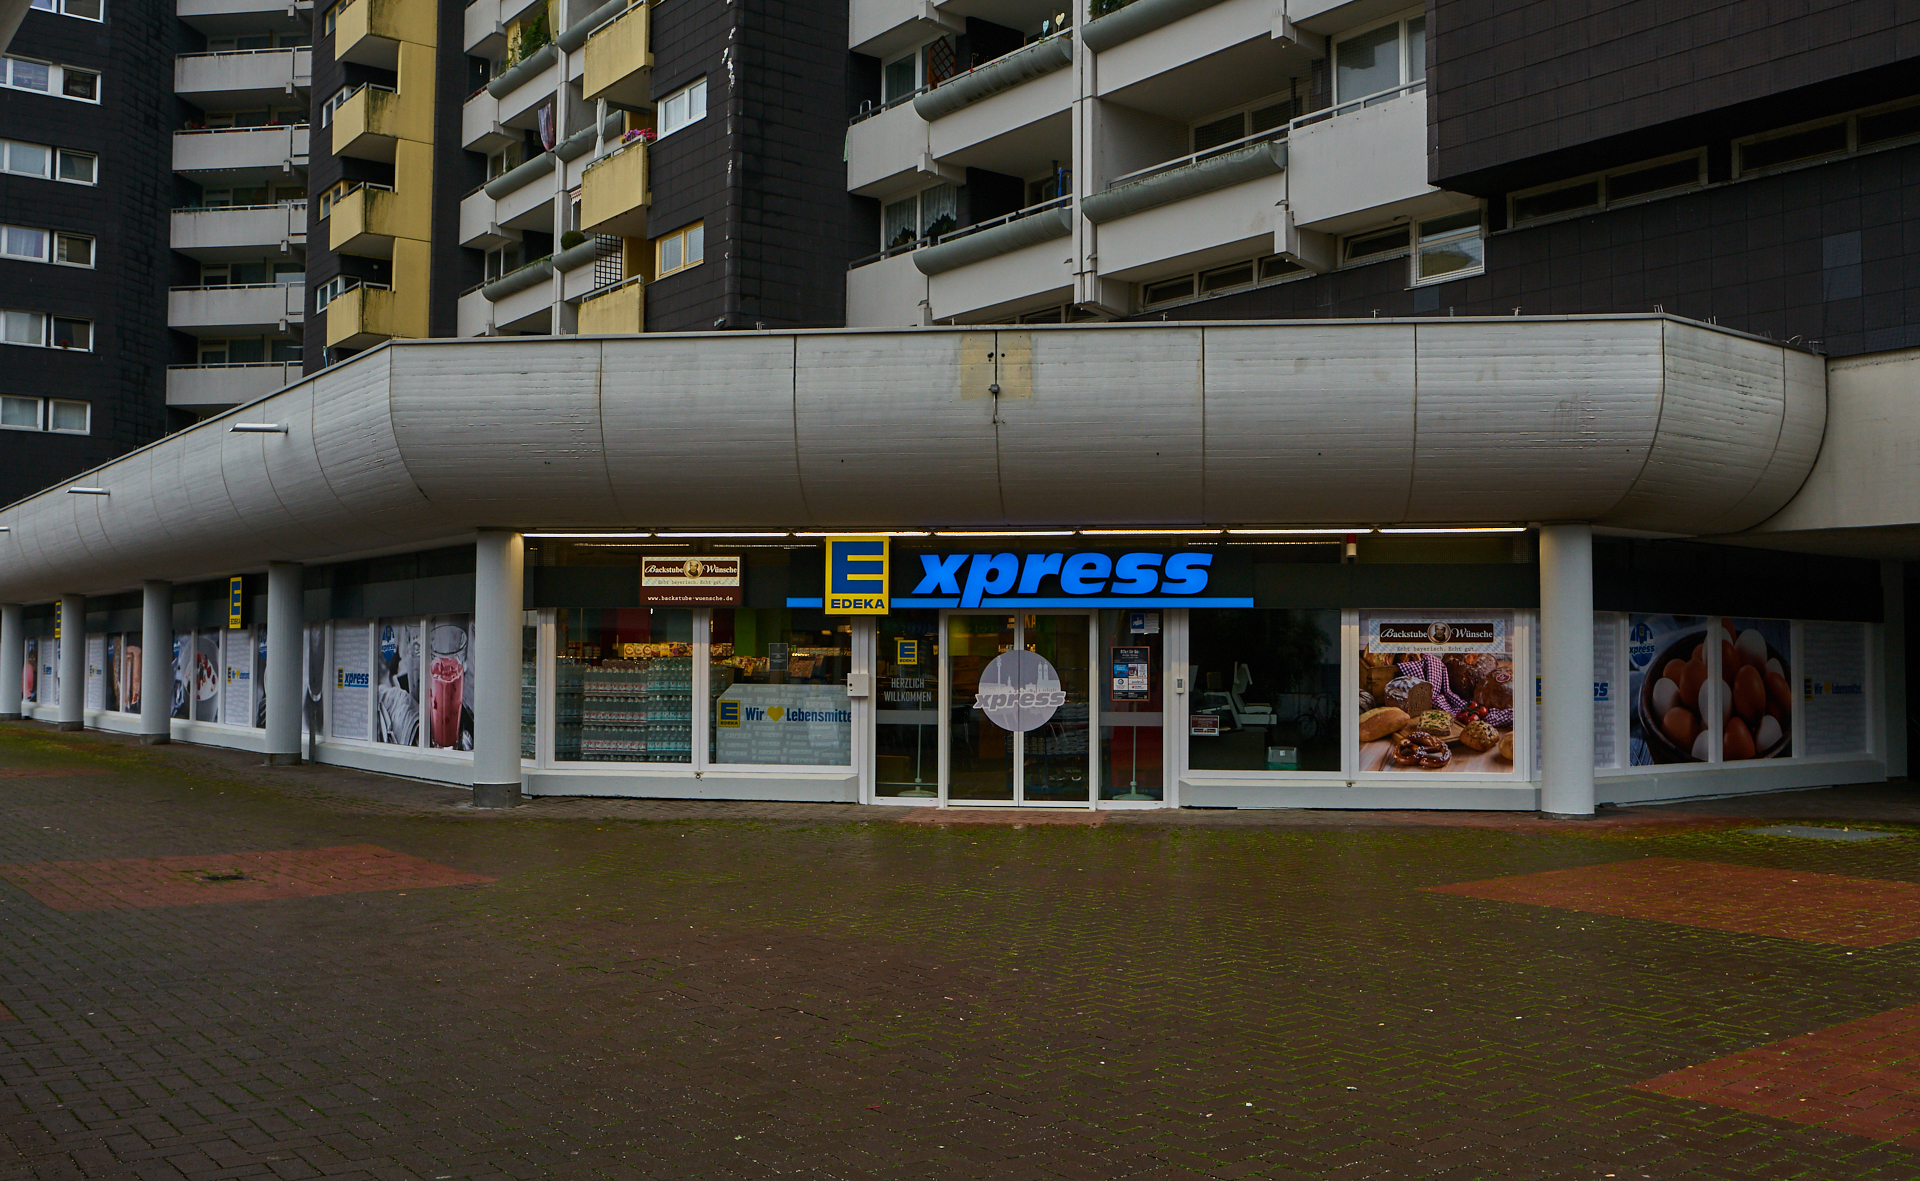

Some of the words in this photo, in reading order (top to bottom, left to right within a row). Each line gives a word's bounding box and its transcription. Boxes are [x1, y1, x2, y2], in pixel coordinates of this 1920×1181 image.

[644, 564, 684, 574] Backstube
[703, 564, 738, 574] Wünsche
[832, 541, 884, 594] E
[910, 552, 1214, 608] xpress
[231, 581, 241, 615] E
[831, 599, 885, 609] EDEKA
[1380, 627, 1428, 638] Backstube
[1451, 627, 1493, 638] Wünsche
[900, 642, 916, 658] E
[1629, 644, 1655, 654] xpress
[344, 672, 369, 686] xpress
[891, 677, 925, 689] HERZLICH
[883, 691, 932, 702] WILLKOMMEN
[974, 692, 1066, 710] xpress
[720, 702, 738, 720] E
[745, 707, 765, 721] Wir
